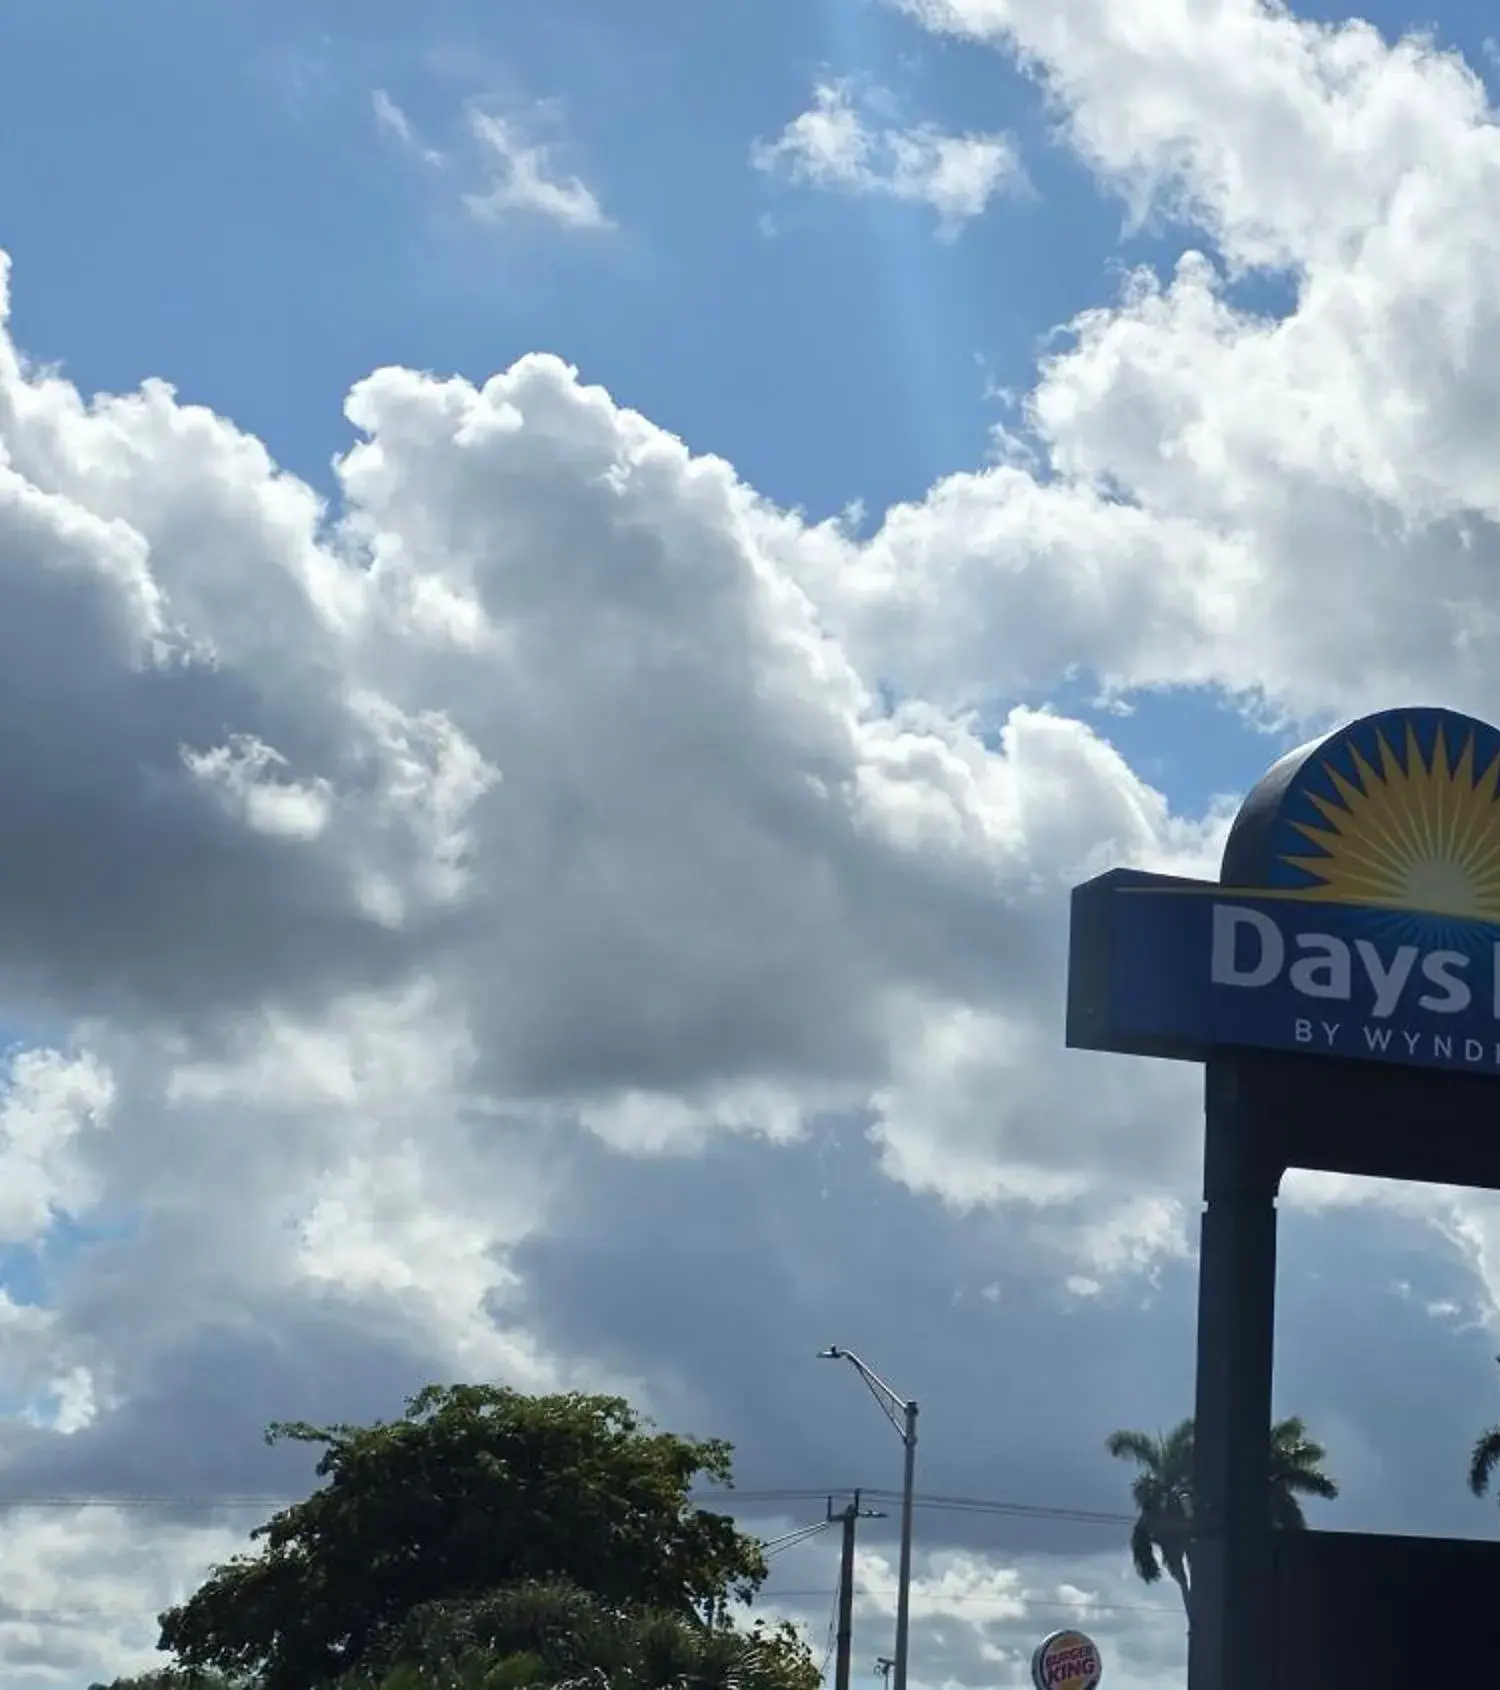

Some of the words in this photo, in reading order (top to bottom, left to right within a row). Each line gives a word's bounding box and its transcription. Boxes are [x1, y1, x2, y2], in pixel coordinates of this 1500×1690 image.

[1211, 904, 1472, 1017] Days
[1295, 1018, 1340, 1045] BY
[1046, 1658, 1095, 1685] KING
